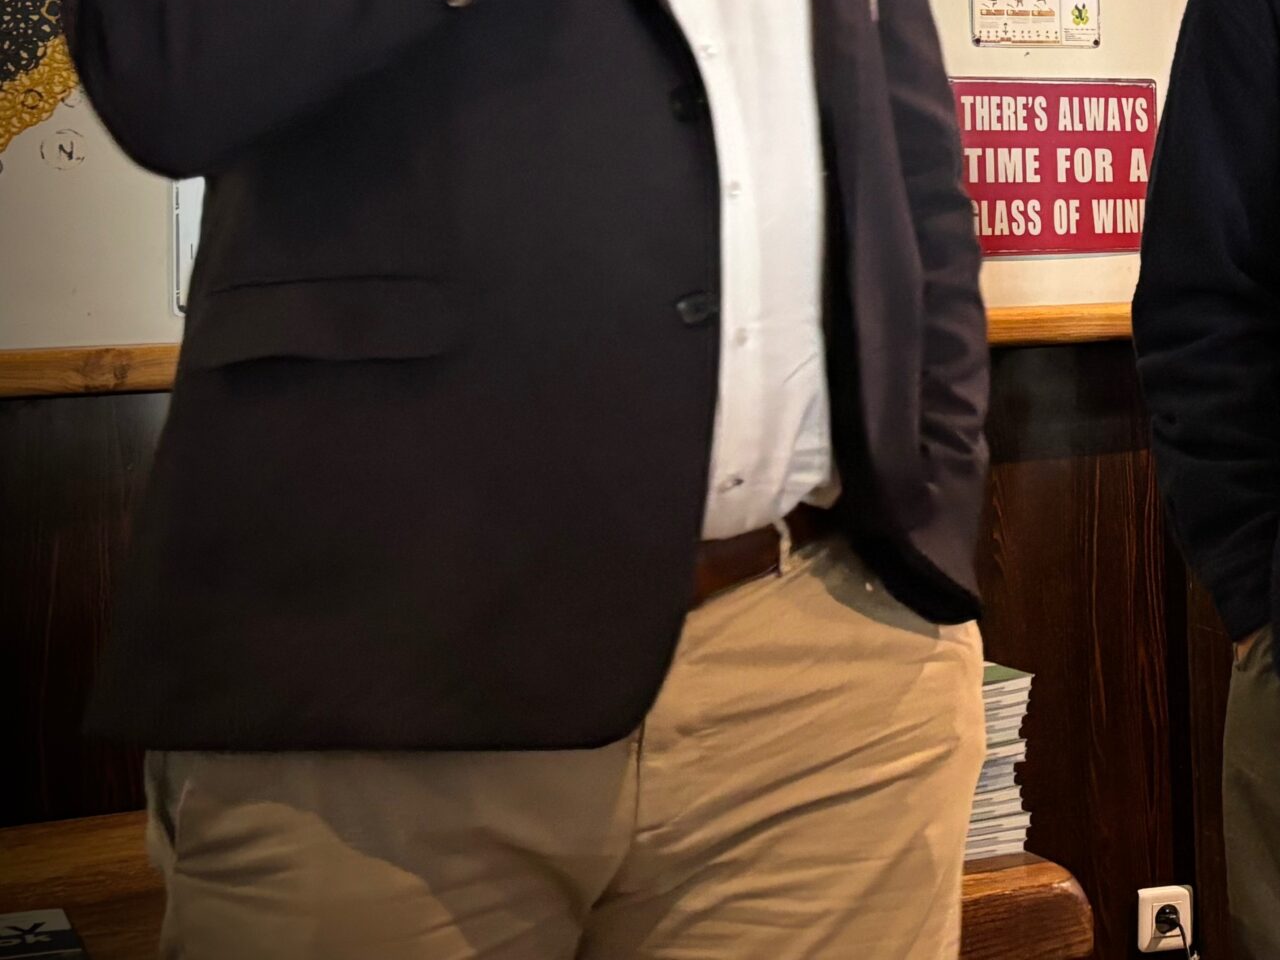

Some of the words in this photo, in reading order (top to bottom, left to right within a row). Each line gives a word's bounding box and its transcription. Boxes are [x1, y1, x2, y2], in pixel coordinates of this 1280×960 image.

[960, 95, 1048, 132] THERE'S
[1058, 96, 1149, 133] ALWAYS
[964, 147, 1041, 184] TIME
[1056, 147, 1113, 183] FOR
[1129, 147, 1148, 183] A
[1053, 198, 1080, 235] OF
